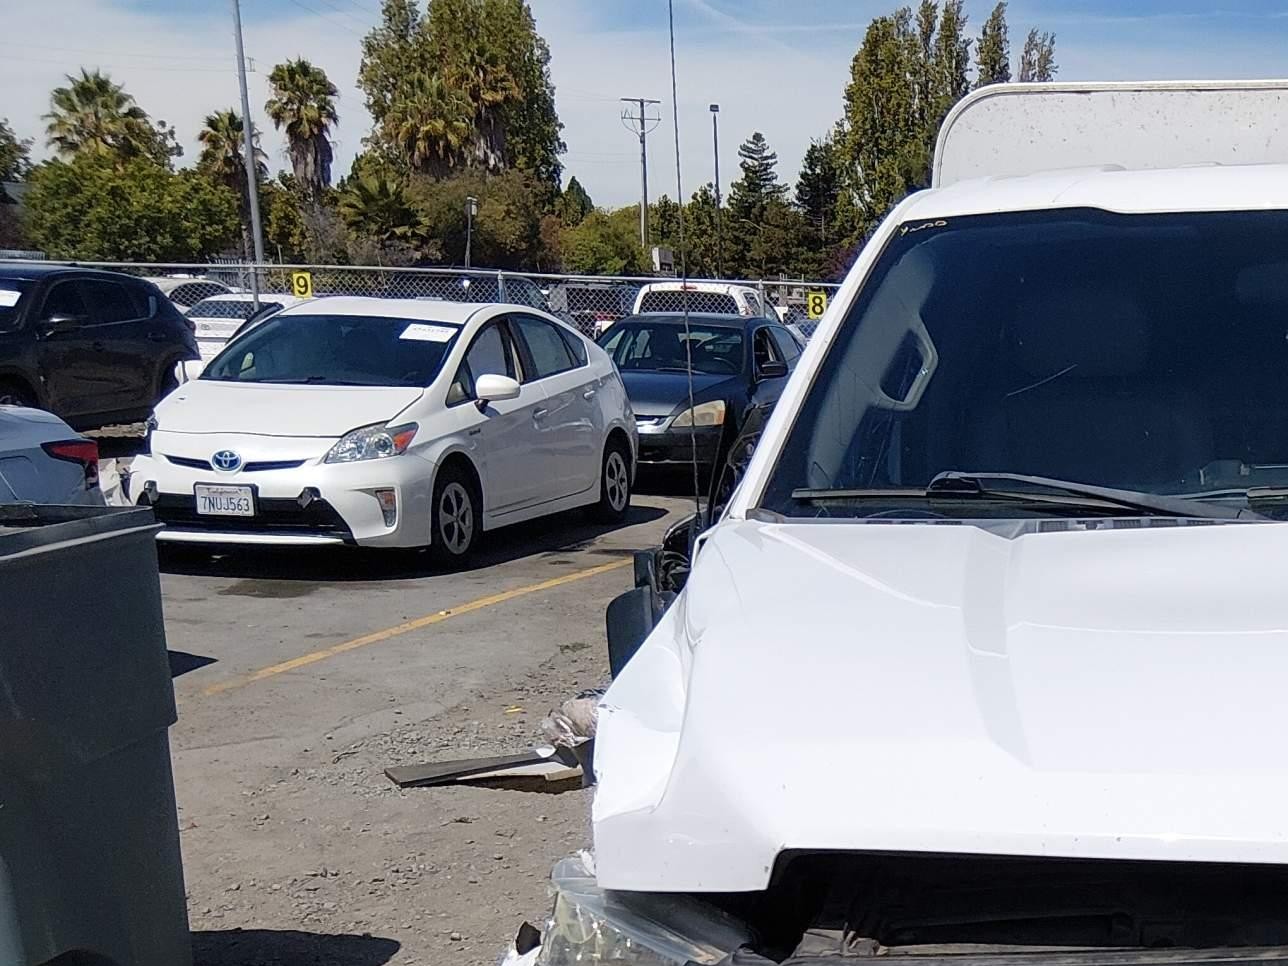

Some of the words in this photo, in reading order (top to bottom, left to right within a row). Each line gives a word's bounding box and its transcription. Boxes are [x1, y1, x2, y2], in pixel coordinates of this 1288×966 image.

[296, 275, 309, 295] 9
[811, 295, 825, 315] 8
[200, 495, 250, 513] 7NUJ563
